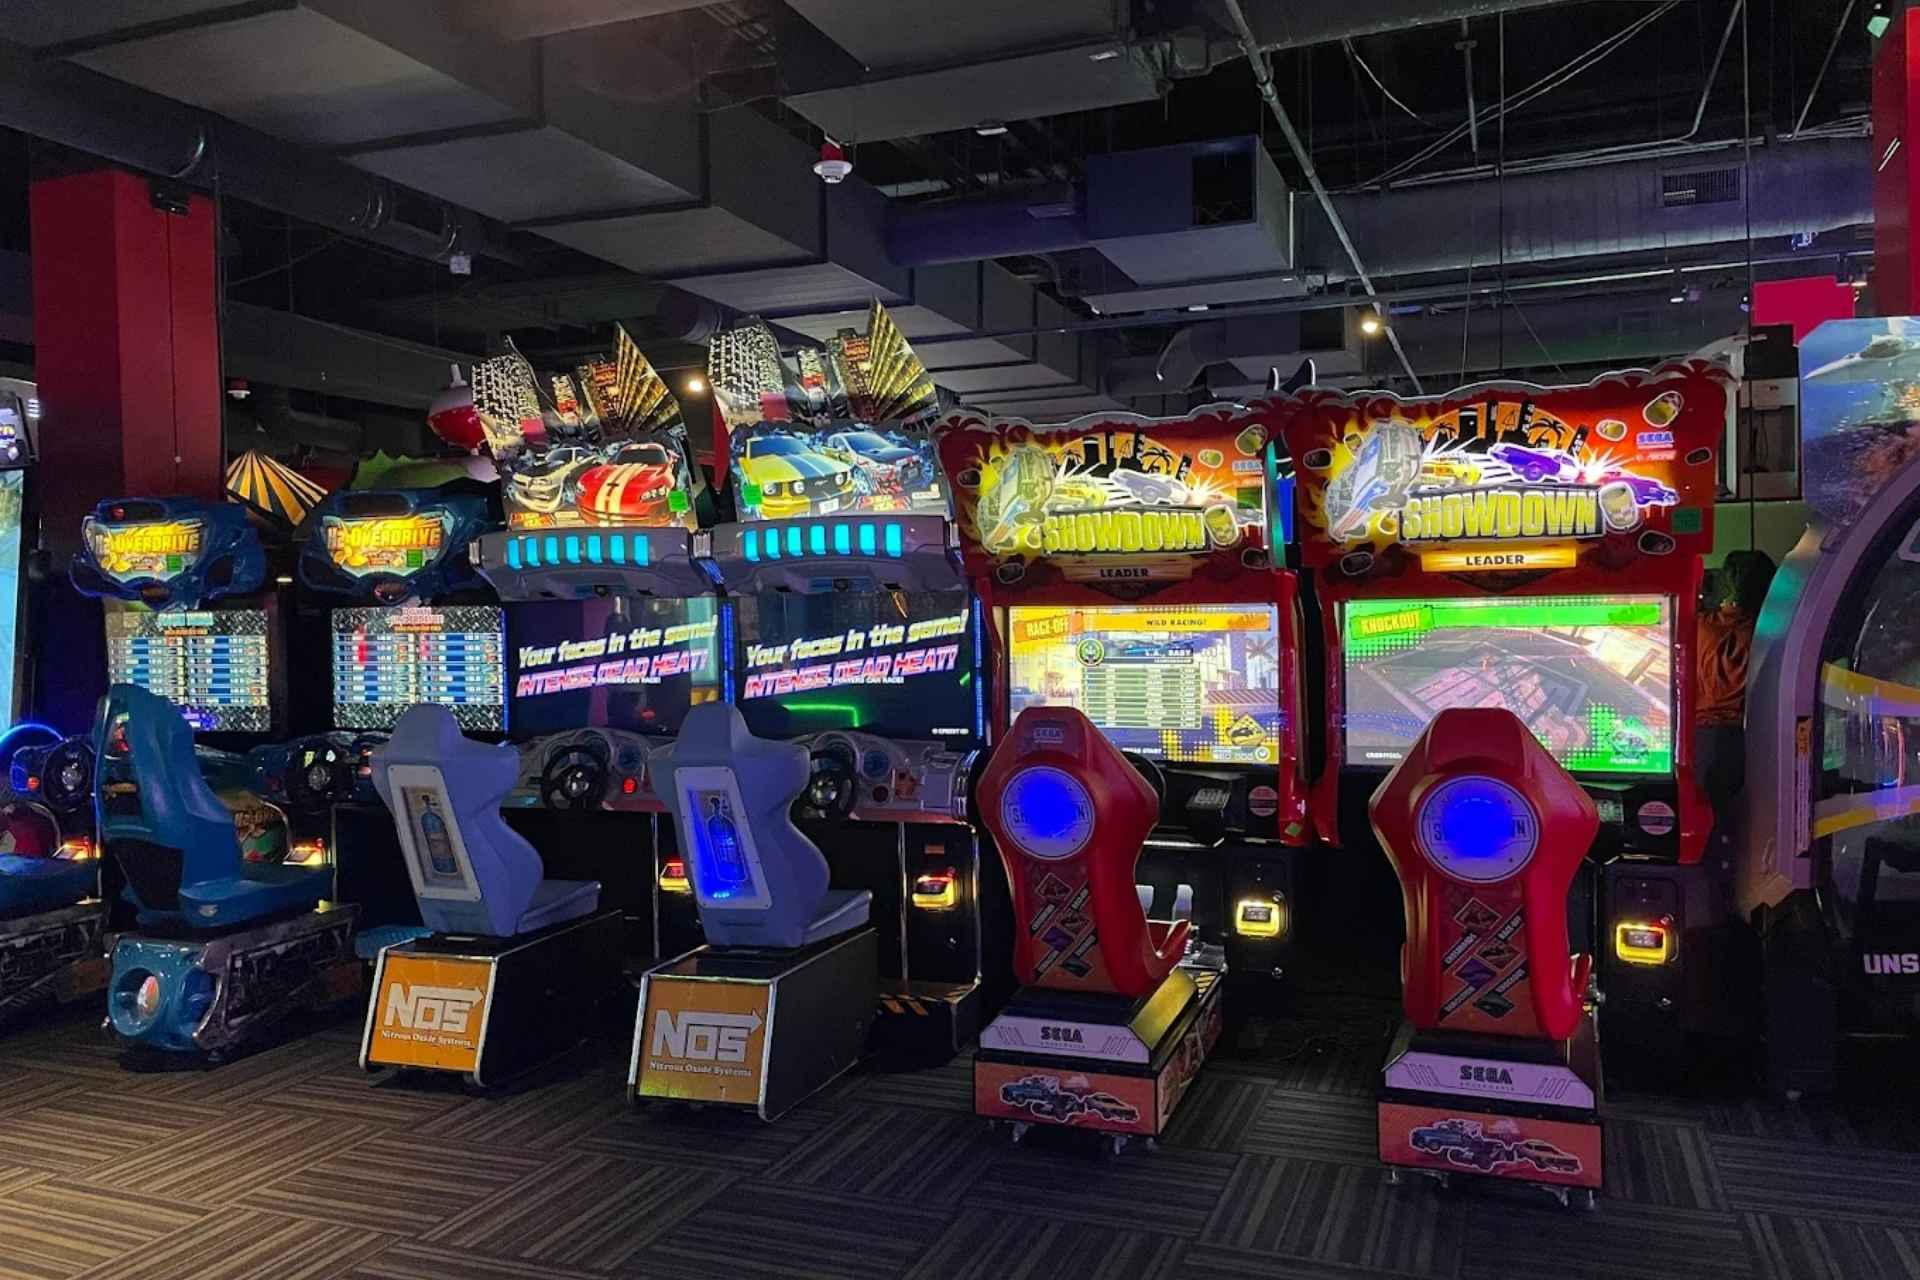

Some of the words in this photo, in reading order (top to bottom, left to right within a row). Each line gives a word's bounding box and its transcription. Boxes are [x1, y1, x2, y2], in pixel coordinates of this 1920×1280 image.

[1402, 489, 1598, 539] SHOWDOWN
[1042, 511, 1206, 552] SHOWDOWN
[1100, 566, 1149, 578] LEADER
[1465, 553, 1525, 567] LEADER
[1026, 616, 1068, 637] RACE-OFF
[1361, 611, 1418, 636] KNOCKOUT
[518, 646, 556, 668] Your
[608, 633, 627, 654] in
[629, 627, 661, 649] the
[746, 644, 787, 667] Your
[845, 629, 865, 651] in
[869, 623, 905, 647] the
[595, 656, 650, 684] DEAD
[833, 655, 892, 686] DEAD
[384, 981, 484, 1034] NOS
[652, 1009, 762, 1063] NOS
[1041, 1026, 1083, 1043] SEGA
[650, 1060, 683, 1073] Nitrous
[685, 1064, 713, 1075] Oxide
[715, 1065, 752, 1078] Systems
[1460, 1065, 1512, 1084] SEGA
